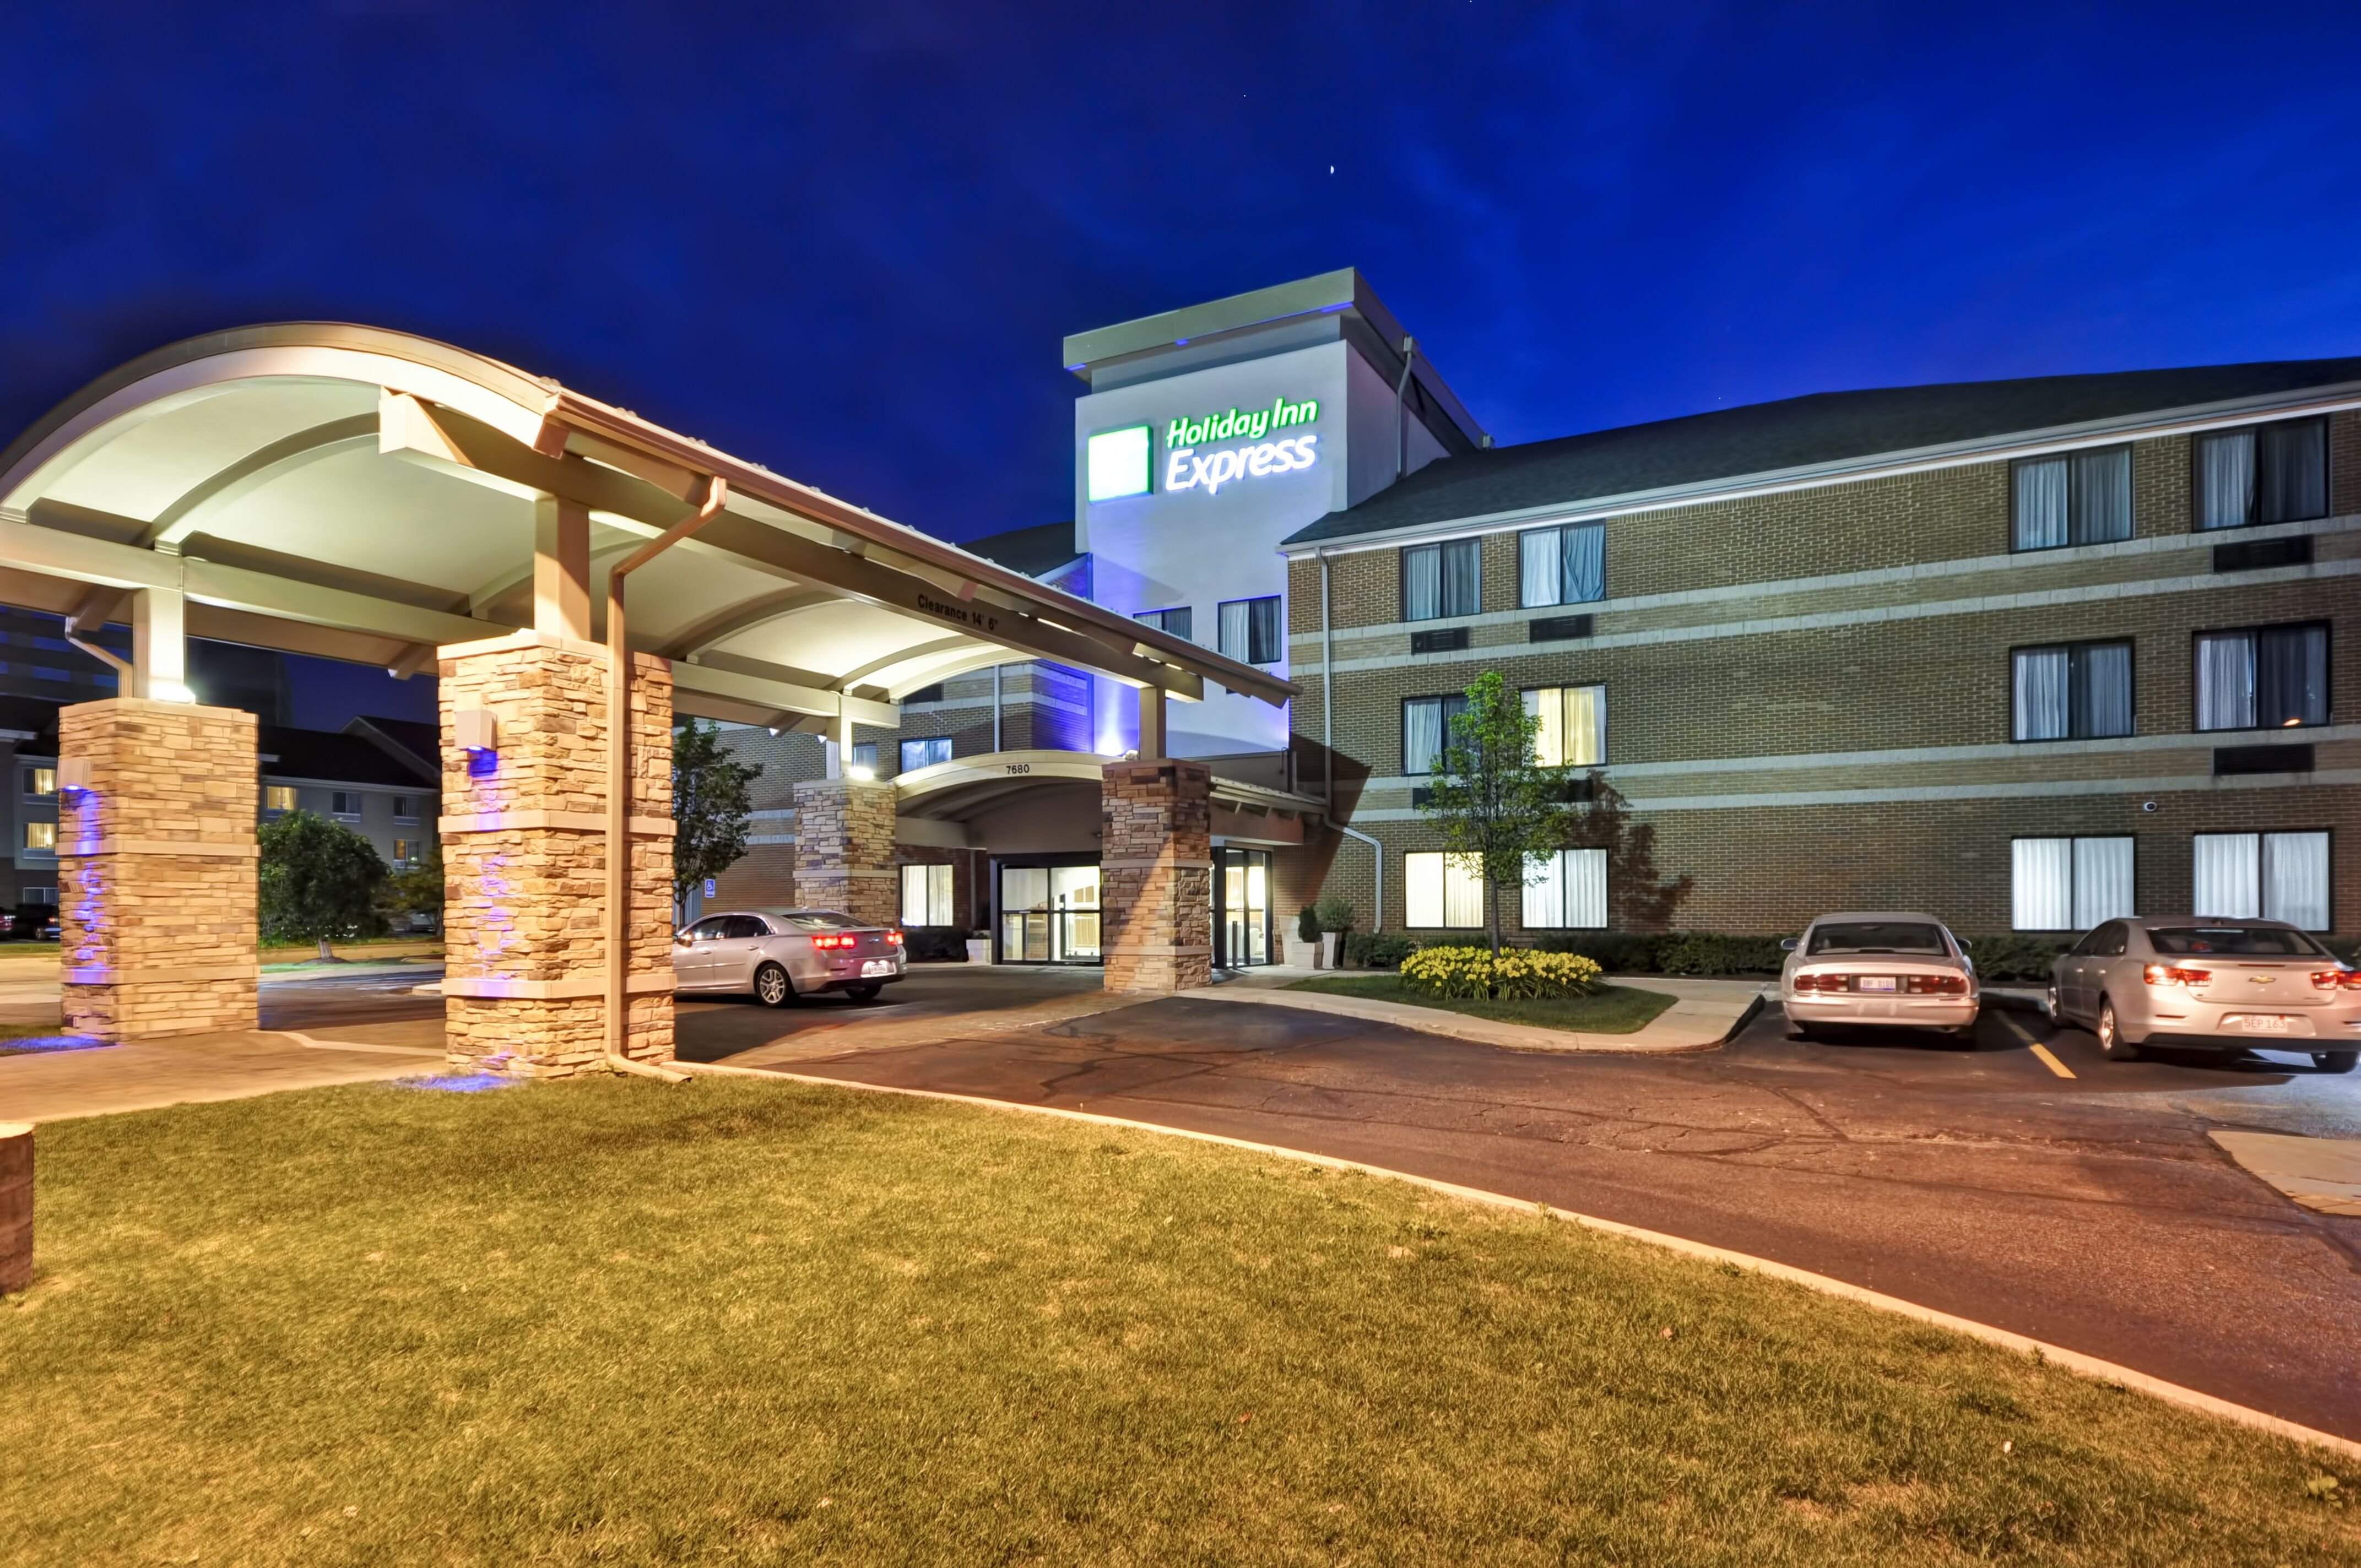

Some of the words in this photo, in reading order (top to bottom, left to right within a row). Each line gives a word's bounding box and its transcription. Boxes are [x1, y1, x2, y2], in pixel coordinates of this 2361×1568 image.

[1165, 408, 1270, 448] Holiday
[1271, 397, 1319, 429] Inn
[1165, 435, 1318, 495] Express
[918, 594, 967, 621] Clearance
[1006, 764, 1030, 774] 7680
